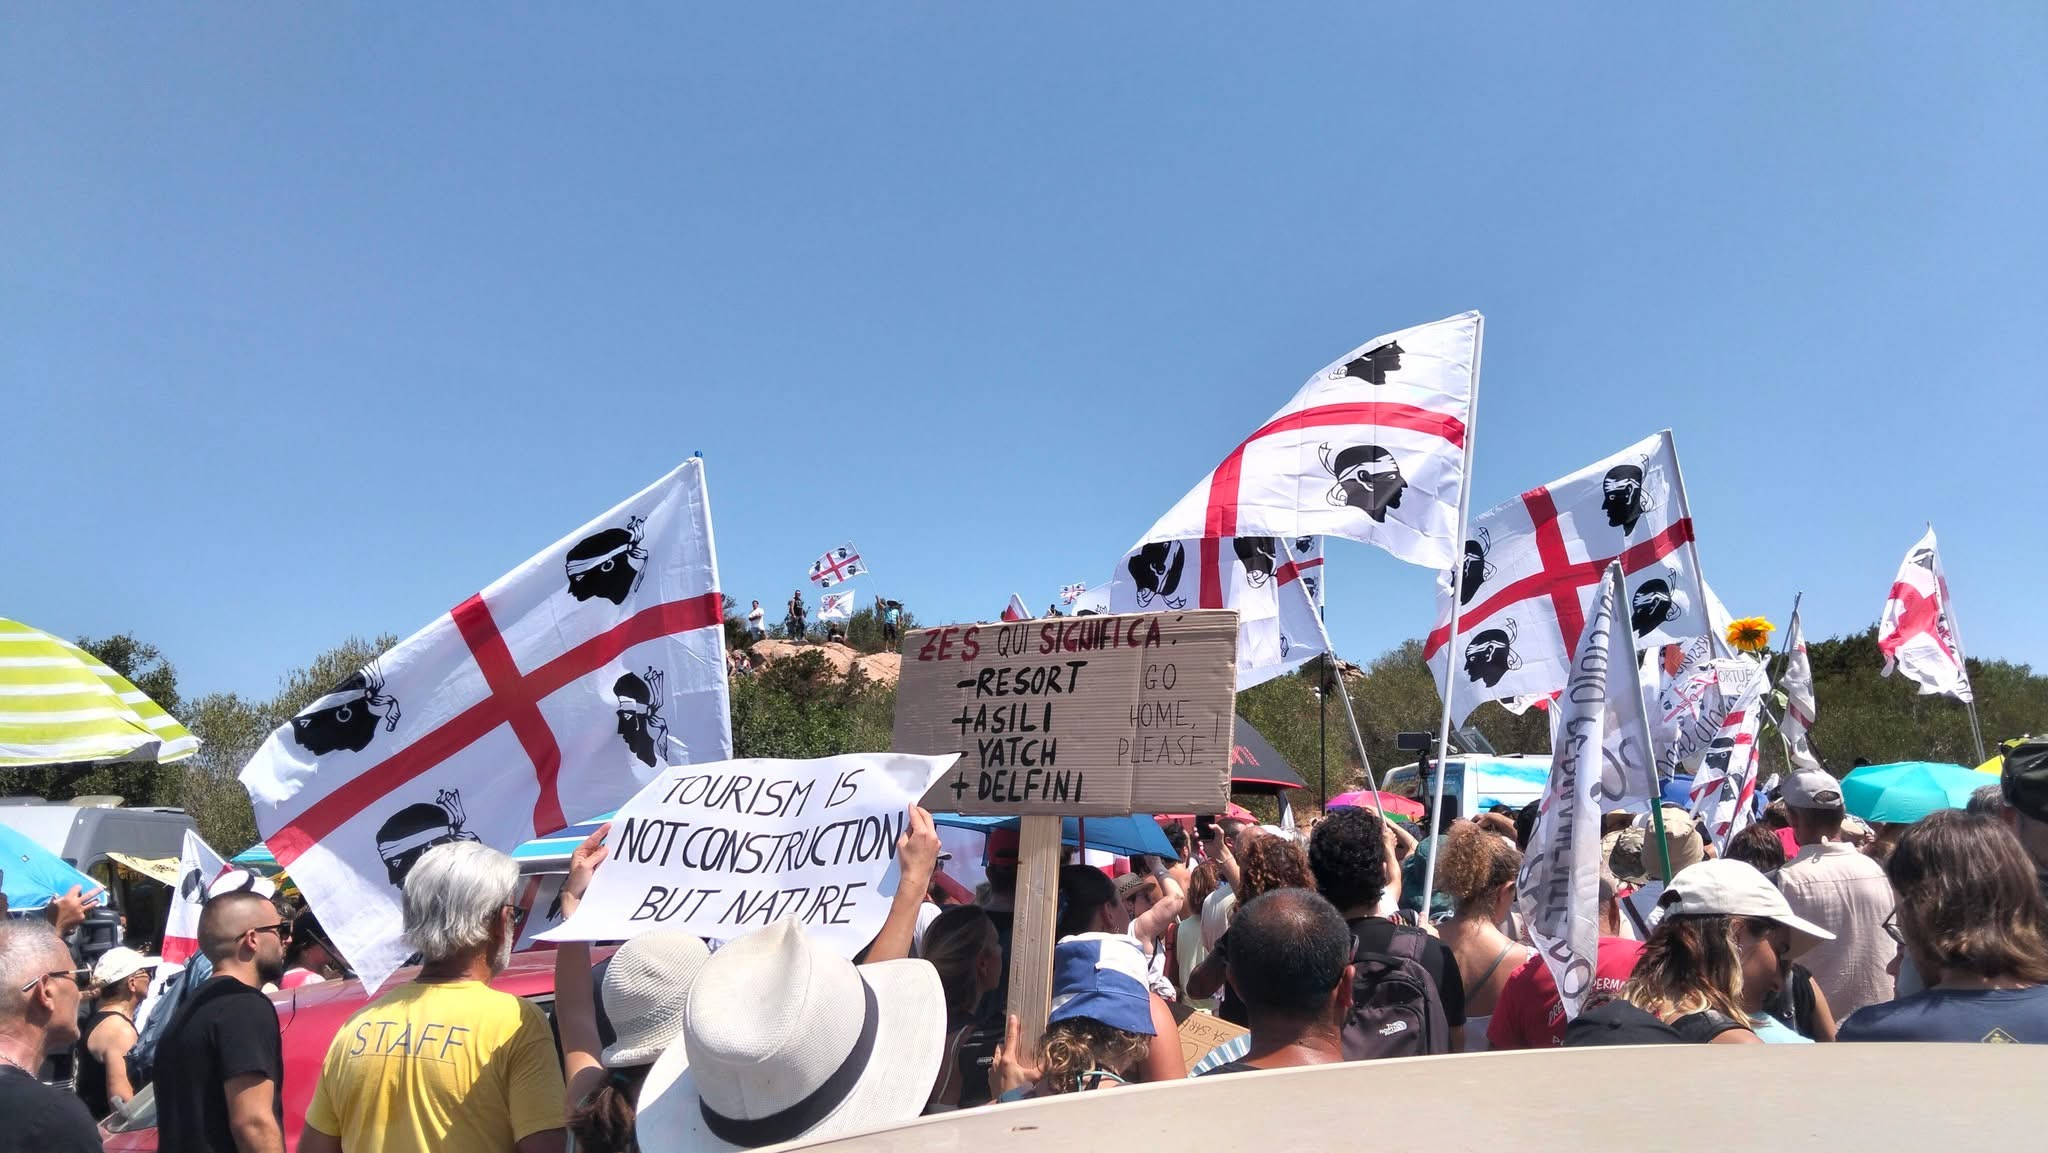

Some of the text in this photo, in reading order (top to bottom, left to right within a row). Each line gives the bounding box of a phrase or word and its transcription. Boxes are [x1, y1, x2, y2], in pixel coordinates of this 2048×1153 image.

[918, 626, 980, 662] ZES
[998, 623, 1029, 658] QUI
[1145, 663, 1177, 691] GO
[1130, 700, 1197, 729] HOME,
[662, 768, 866, 817] TOURISM IS
[613, 811, 903, 874] NOT CONSTRUCTION
[630, 882, 867, 925] BUT NATURE
[350, 1021, 470, 1059] STAFF
